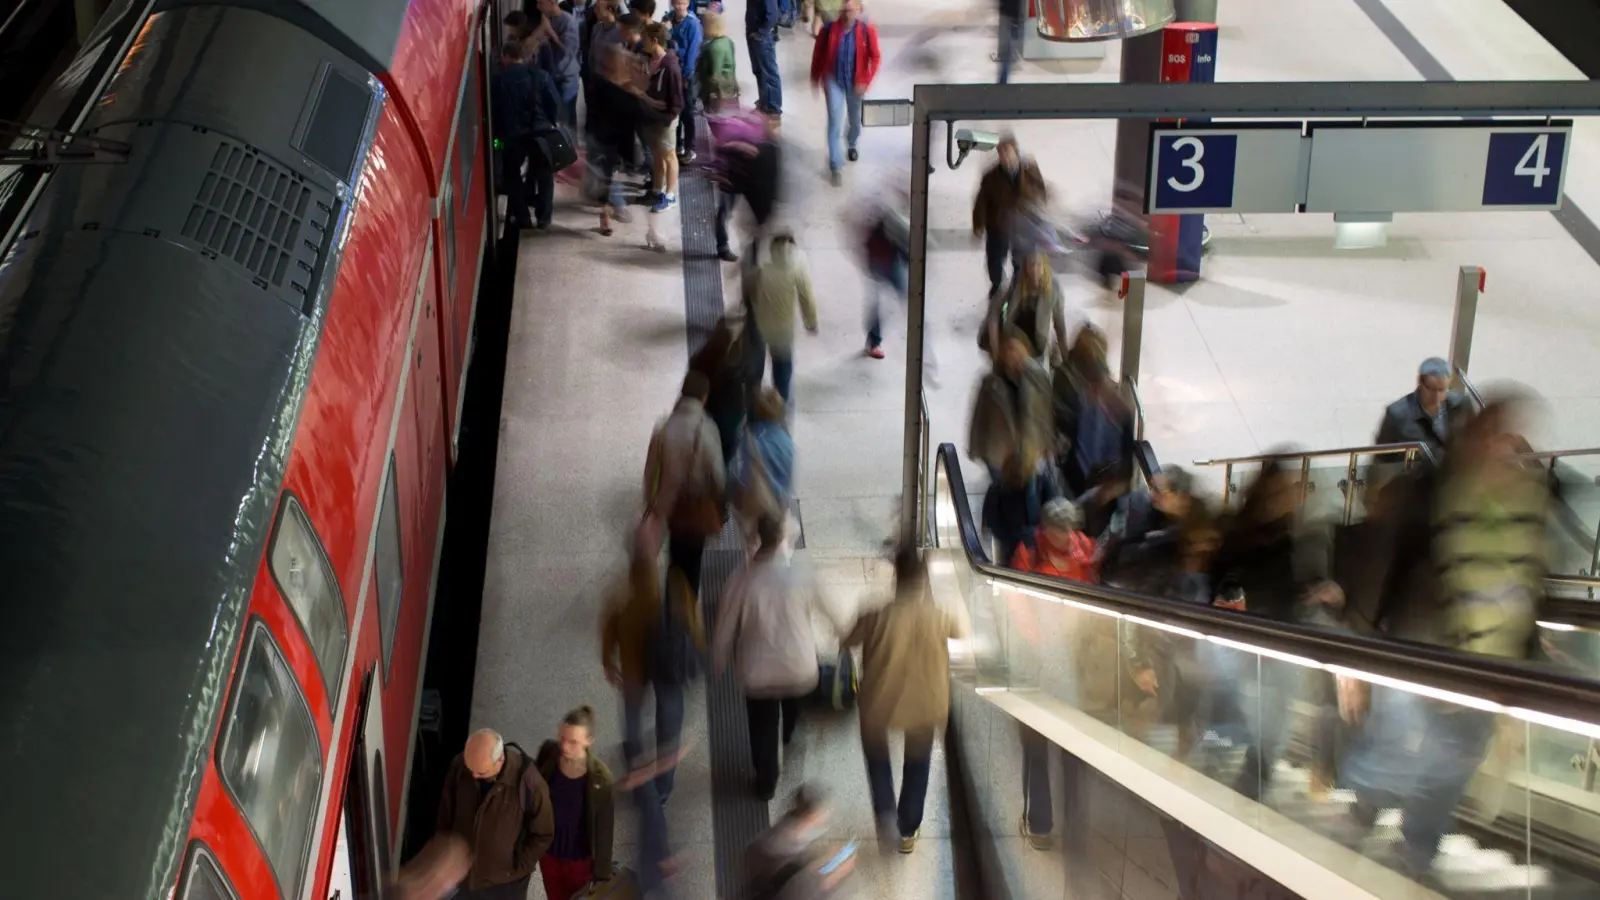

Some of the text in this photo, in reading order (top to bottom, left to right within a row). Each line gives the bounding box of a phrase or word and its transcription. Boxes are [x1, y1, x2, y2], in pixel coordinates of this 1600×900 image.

[1168, 54, 1186, 64] SOS
[1197, 54, 1212, 63] Info
[1167, 136, 1205, 192] 3
[1514, 133, 1551, 188] 4
